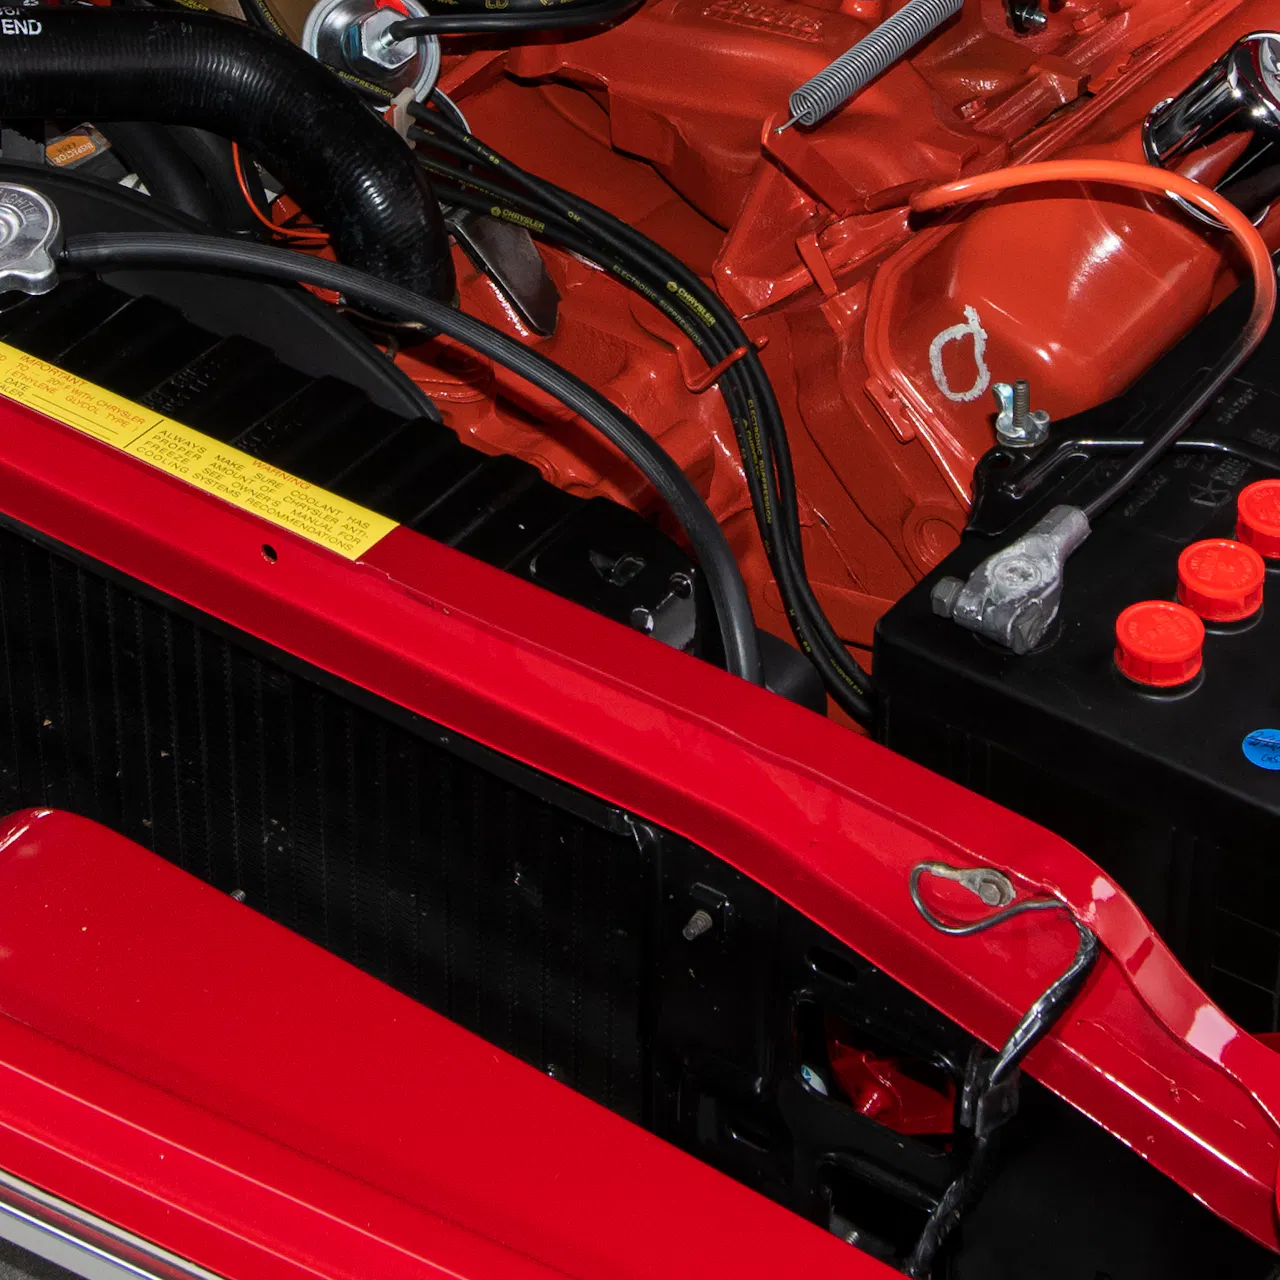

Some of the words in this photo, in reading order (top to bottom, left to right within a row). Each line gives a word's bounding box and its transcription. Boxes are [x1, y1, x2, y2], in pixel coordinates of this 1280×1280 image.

[1, 18, 42, 35] END
[337, 71, 394, 98] SUPPRESSION
[53, 142, 94, 164] INSPECTOR
[501, 207, 546, 231] CHRYSLER
[612, 263, 658, 302] ELECTRONIC
[658, 299, 704, 346] SUPPRESSION
[677, 287, 717, 325] CHRYSLER
[3, 377, 31, 391] DATE
[18, 355, 86, 387] IMPORTANT
[14, 363, 30, 371] TO
[69, 388, 95, 400] WITH
[94, 399, 146, 424] CHRYSLER
[63, 395, 101, 413] GLYCOL
[103, 413, 130, 427] TYPE
[150, 435, 202, 460] PROPER
[208, 462, 255, 485] AMOUNT
[258, 485, 276, 494] OF
[281, 496, 339, 523] CHRYSLER
[158, 429, 207, 453] ALWAYS
[213, 455, 245, 470] MAKE
[252, 473, 284, 488] SURE
[289, 490, 342, 515] COOLANT
[346, 516, 370, 528] HAS
[250, 460, 311, 489] WARNING
[134, 446, 189, 473] COOLING
[191, 473, 241, 497] SYSTEMS
[244, 497, 354, 550] RECOMMENDATIONS
[142, 441, 190, 464] FREEZE
[200, 468, 224, 480] SEE
[229, 481, 281, 506] OWNER'S
[289, 509, 336, 532] MANUAL
[337, 531, 361, 544] FOR
